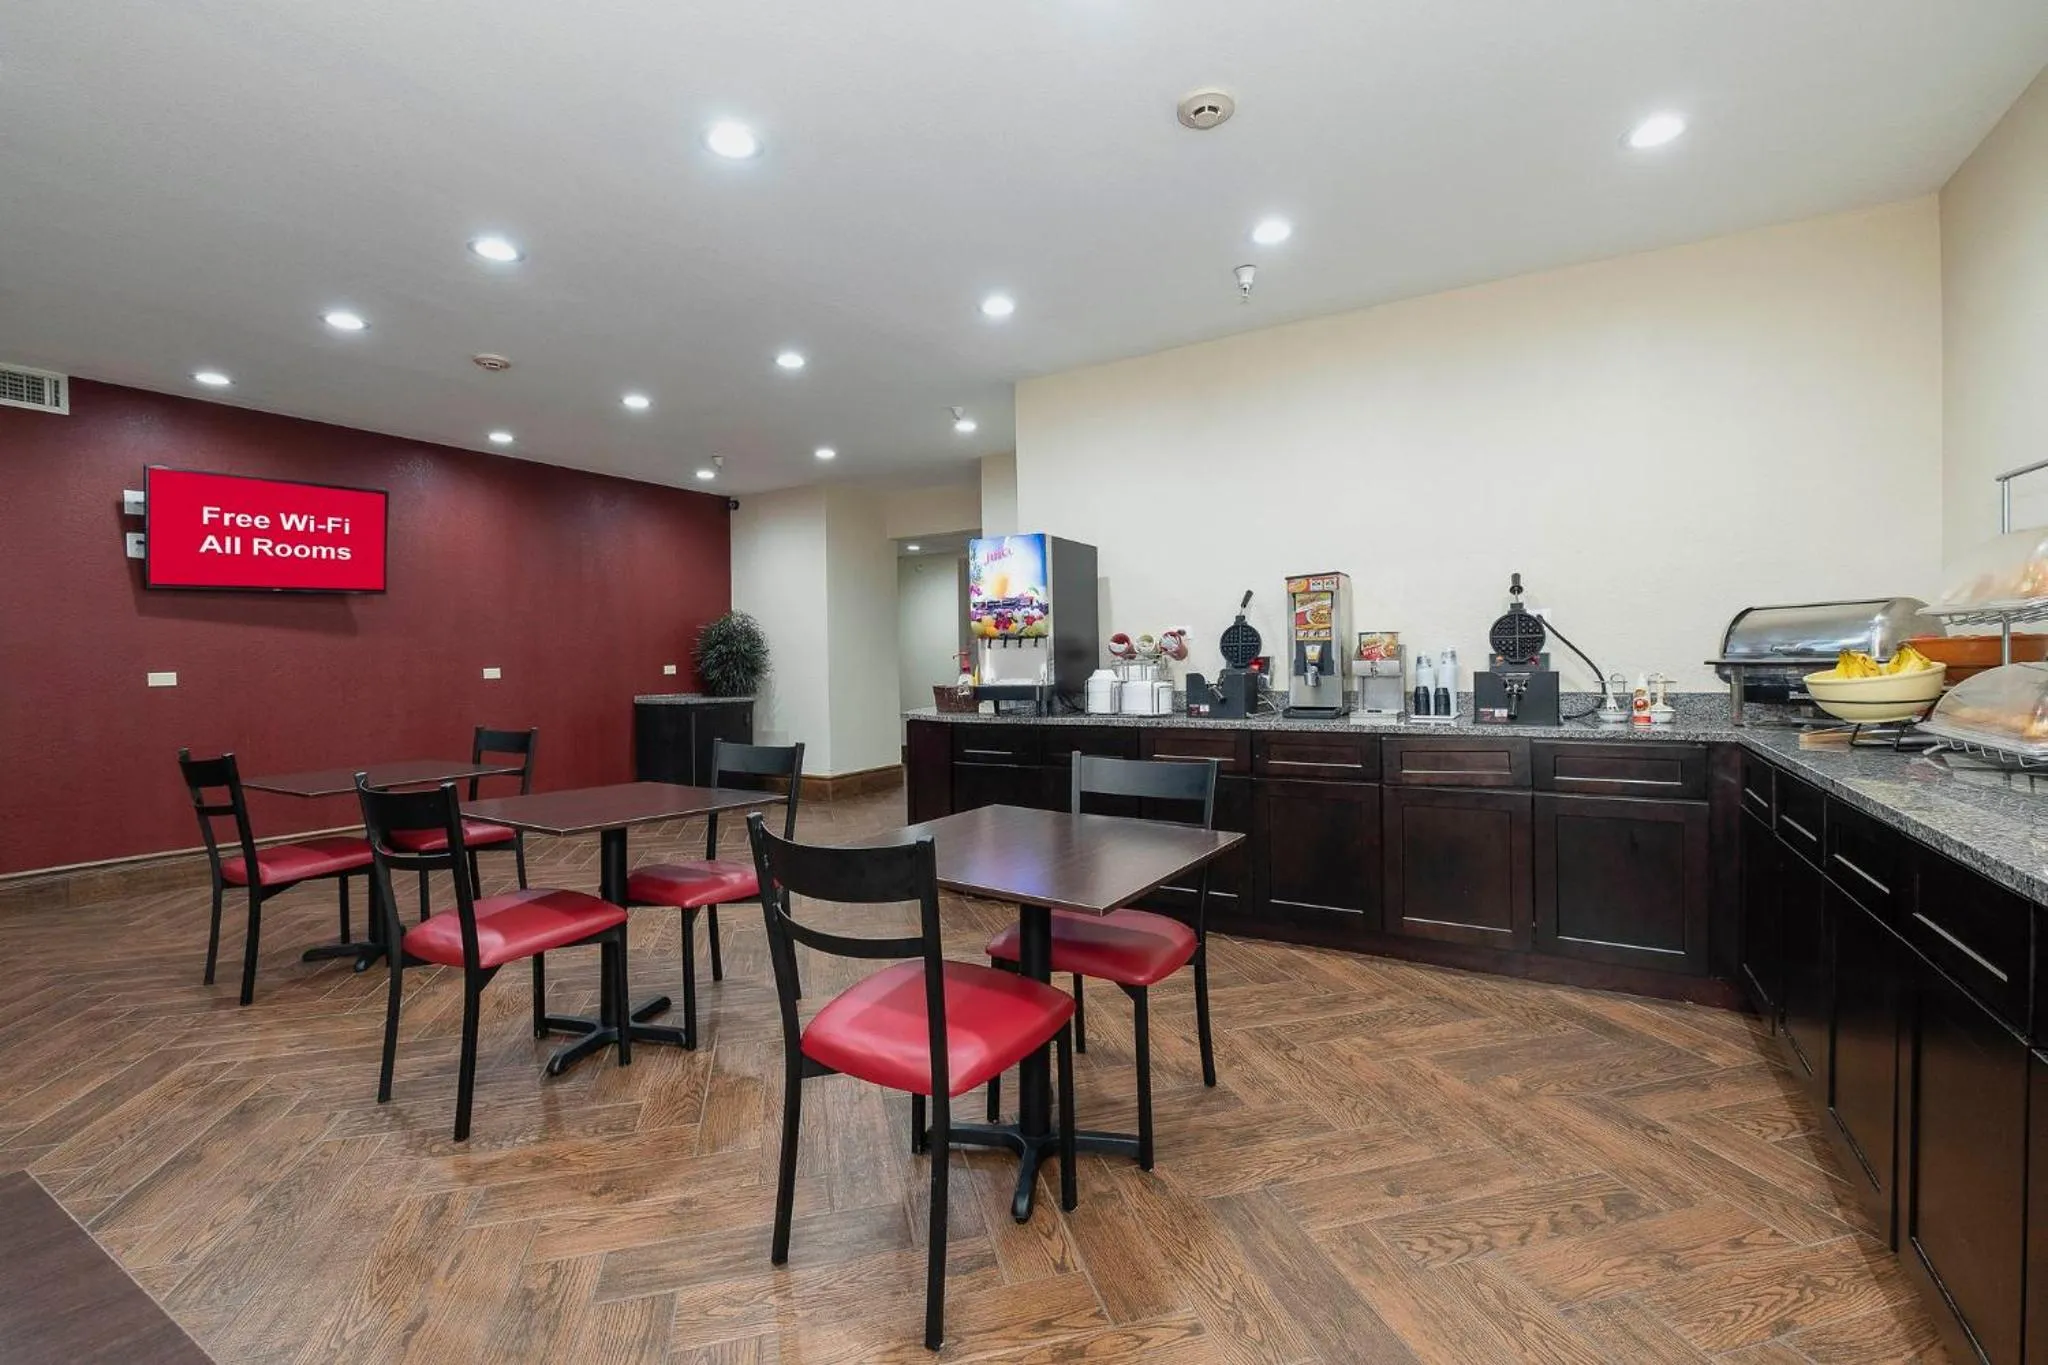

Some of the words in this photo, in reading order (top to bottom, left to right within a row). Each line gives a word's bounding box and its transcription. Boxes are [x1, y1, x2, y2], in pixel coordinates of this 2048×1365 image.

[202, 506, 270, 529] Free
[280, 512, 350, 535] Wi-Fi
[199, 534, 240, 555] All
[253, 537, 351, 561] Rooms
